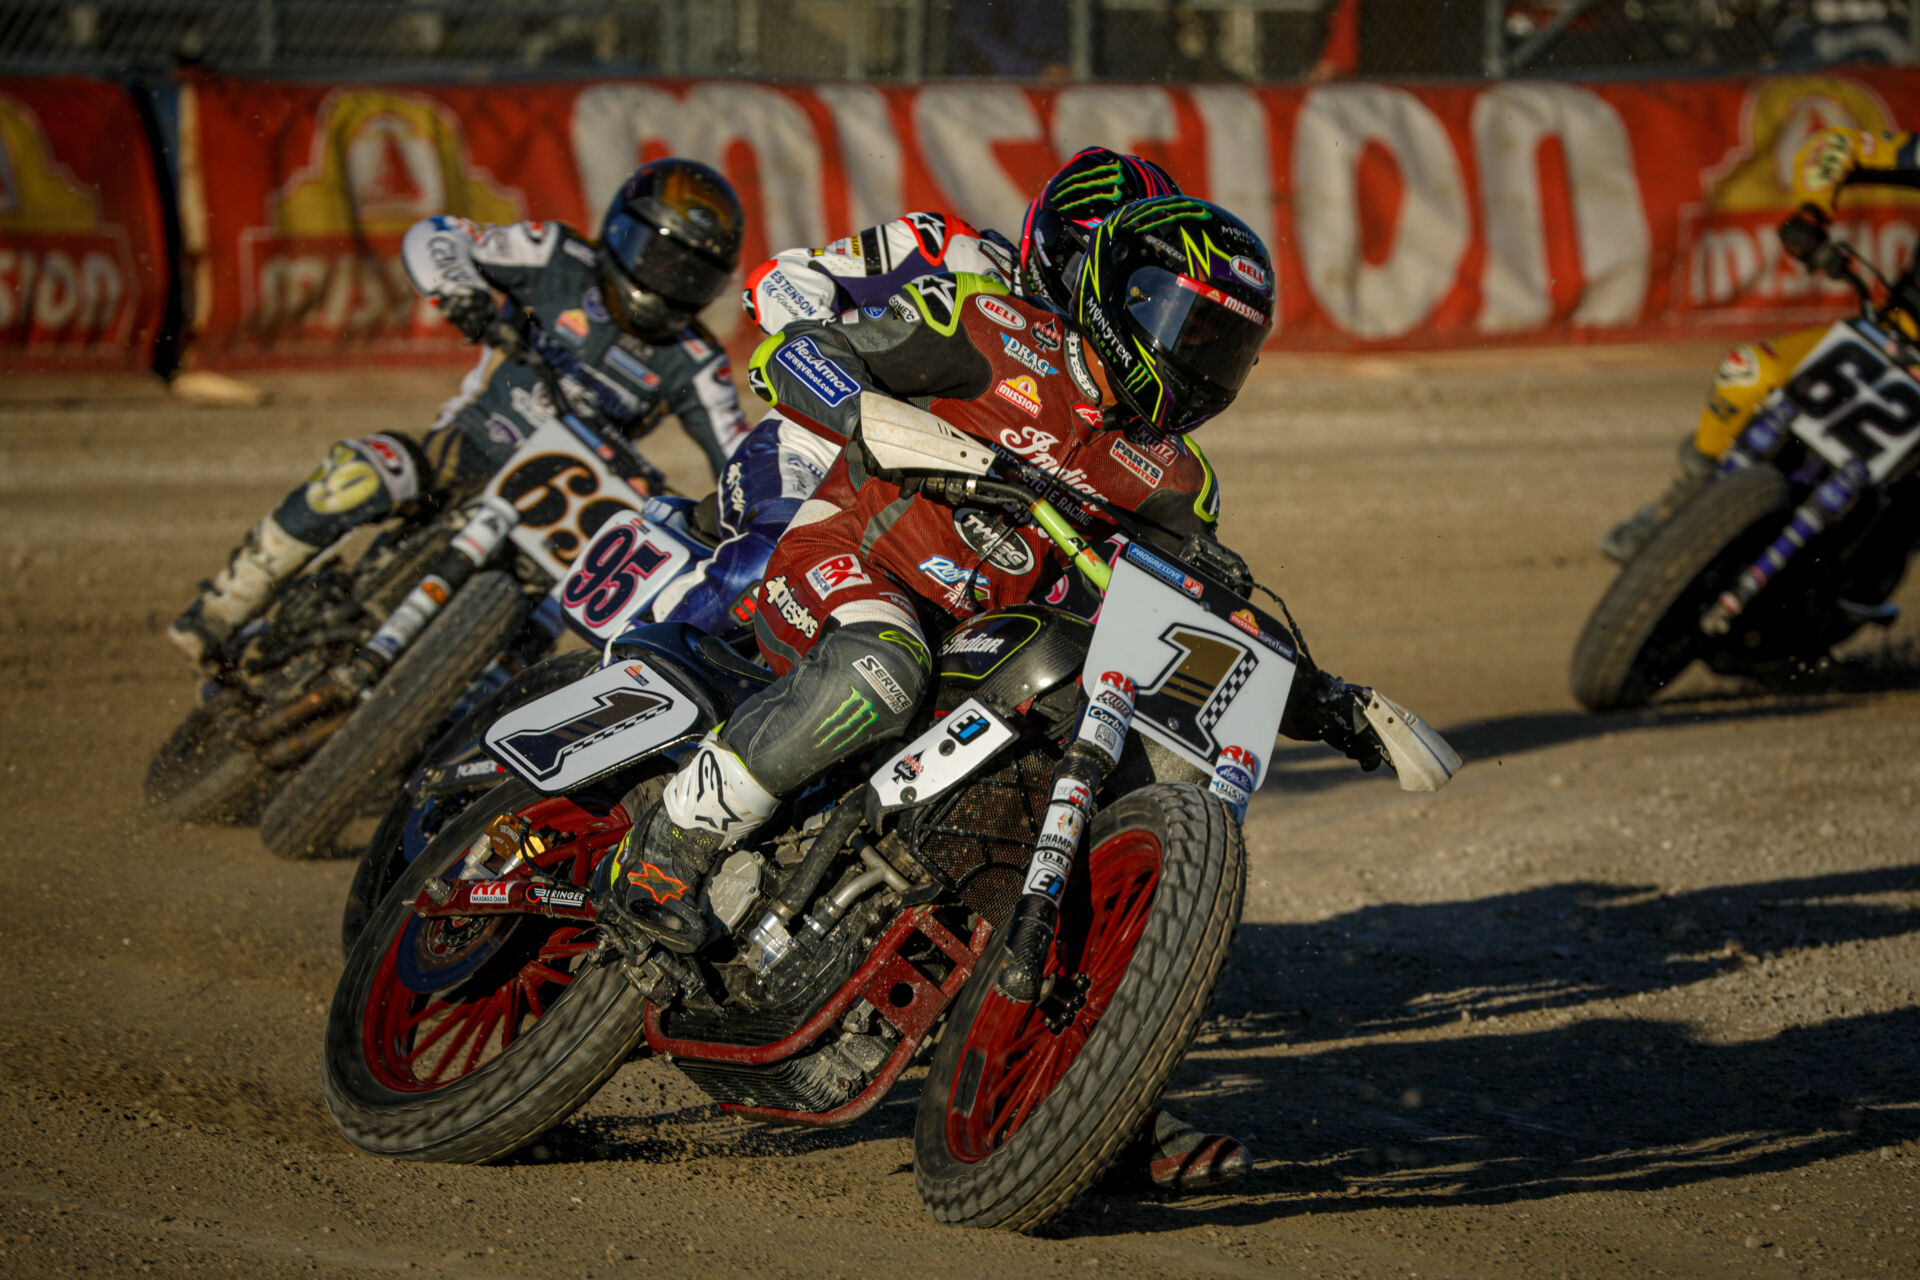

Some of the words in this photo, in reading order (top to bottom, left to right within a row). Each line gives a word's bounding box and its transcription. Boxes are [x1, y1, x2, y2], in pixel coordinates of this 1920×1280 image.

[770, 270, 818, 317] ESTENSON
[1237, 261, 1264, 284] BELL
[983, 300, 1018, 326] BELL
[1005, 336, 1051, 374] DRAG
[1086, 316, 1119, 364] ENERGY
[790, 339, 852, 394] FlexArmor
[1783, 338, 1920, 461] 62
[1111, 449, 1158, 487] UNLIMITED
[1114, 438, 1162, 480] PARTS
[1057, 497, 1094, 527] RACING
[562, 524, 672, 628] 95
[818, 555, 865, 588] RK
[1130, 546, 1183, 581] PROGRESSIVE
[859, 656, 912, 709] SERVICE
[1133, 621, 1260, 762] 1
[885, 695, 903, 714] PRO
[493, 686, 675, 783] 1
